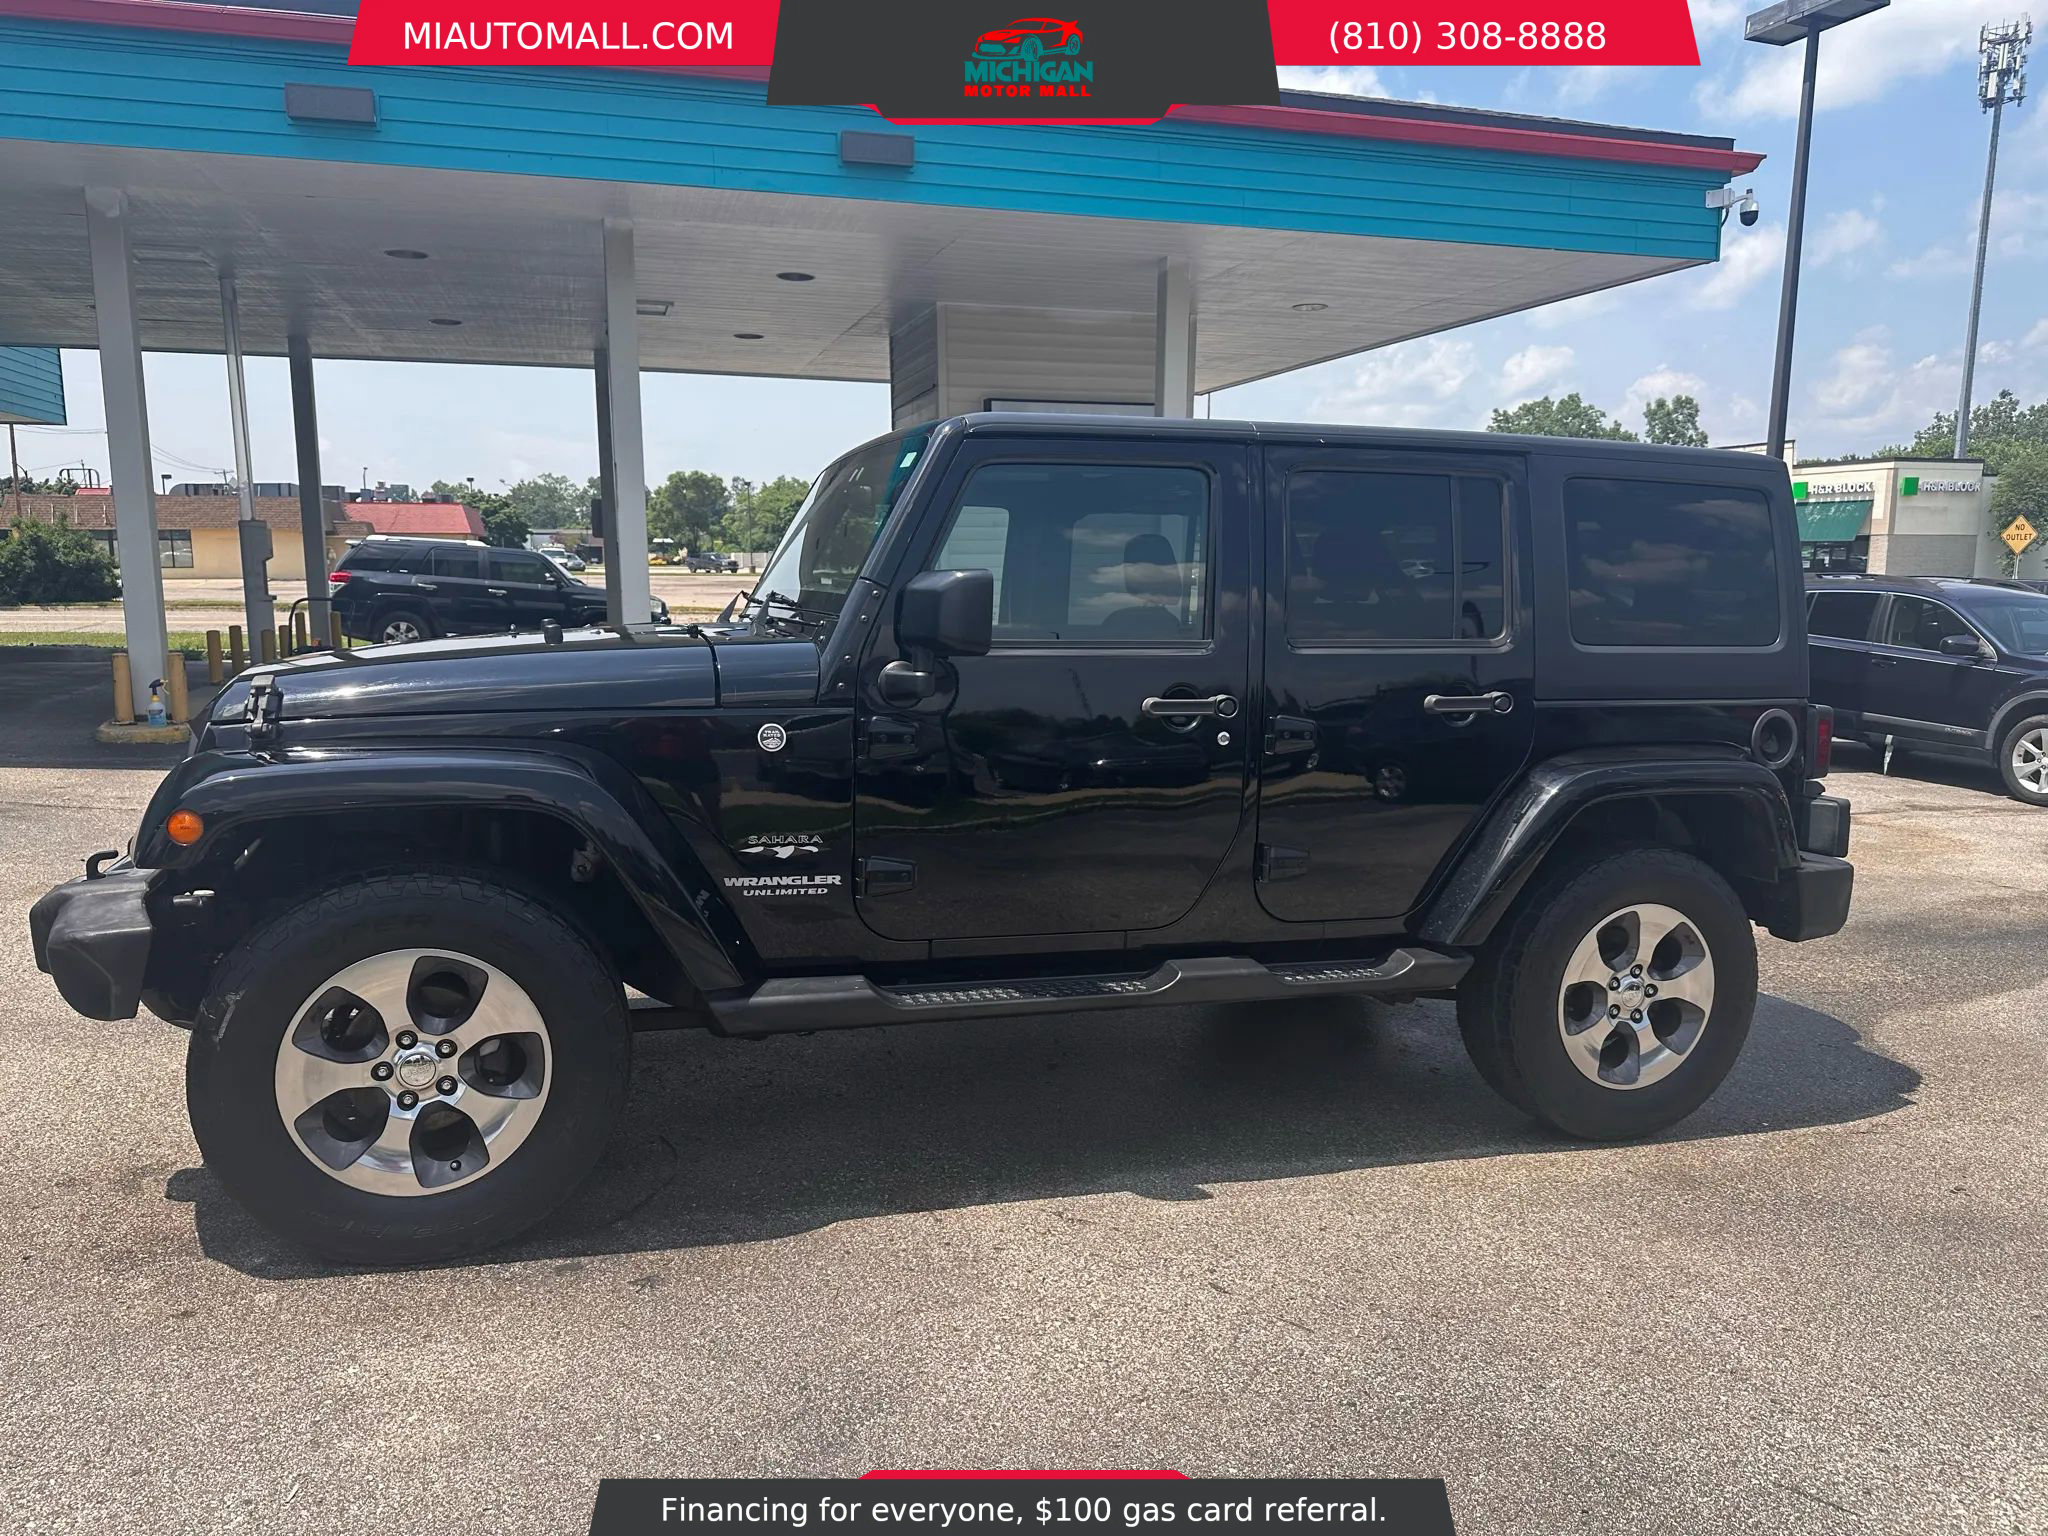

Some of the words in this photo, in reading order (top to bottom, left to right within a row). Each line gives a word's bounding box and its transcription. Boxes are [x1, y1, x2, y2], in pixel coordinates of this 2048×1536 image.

[1811, 483, 1833, 494] H&R
[1834, 482, 1872, 493] BLOCK
[1923, 481, 1945, 492] H&R
[1947, 481, 1982, 492] BLOCK
[2015, 523, 2026, 531] NO
[2005, 533, 2033, 541] OUTLET
[748, 834, 823, 844] SAHARA
[724, 874, 842, 887] WRANGLER
[743, 887, 828, 896] UNLIMITED
